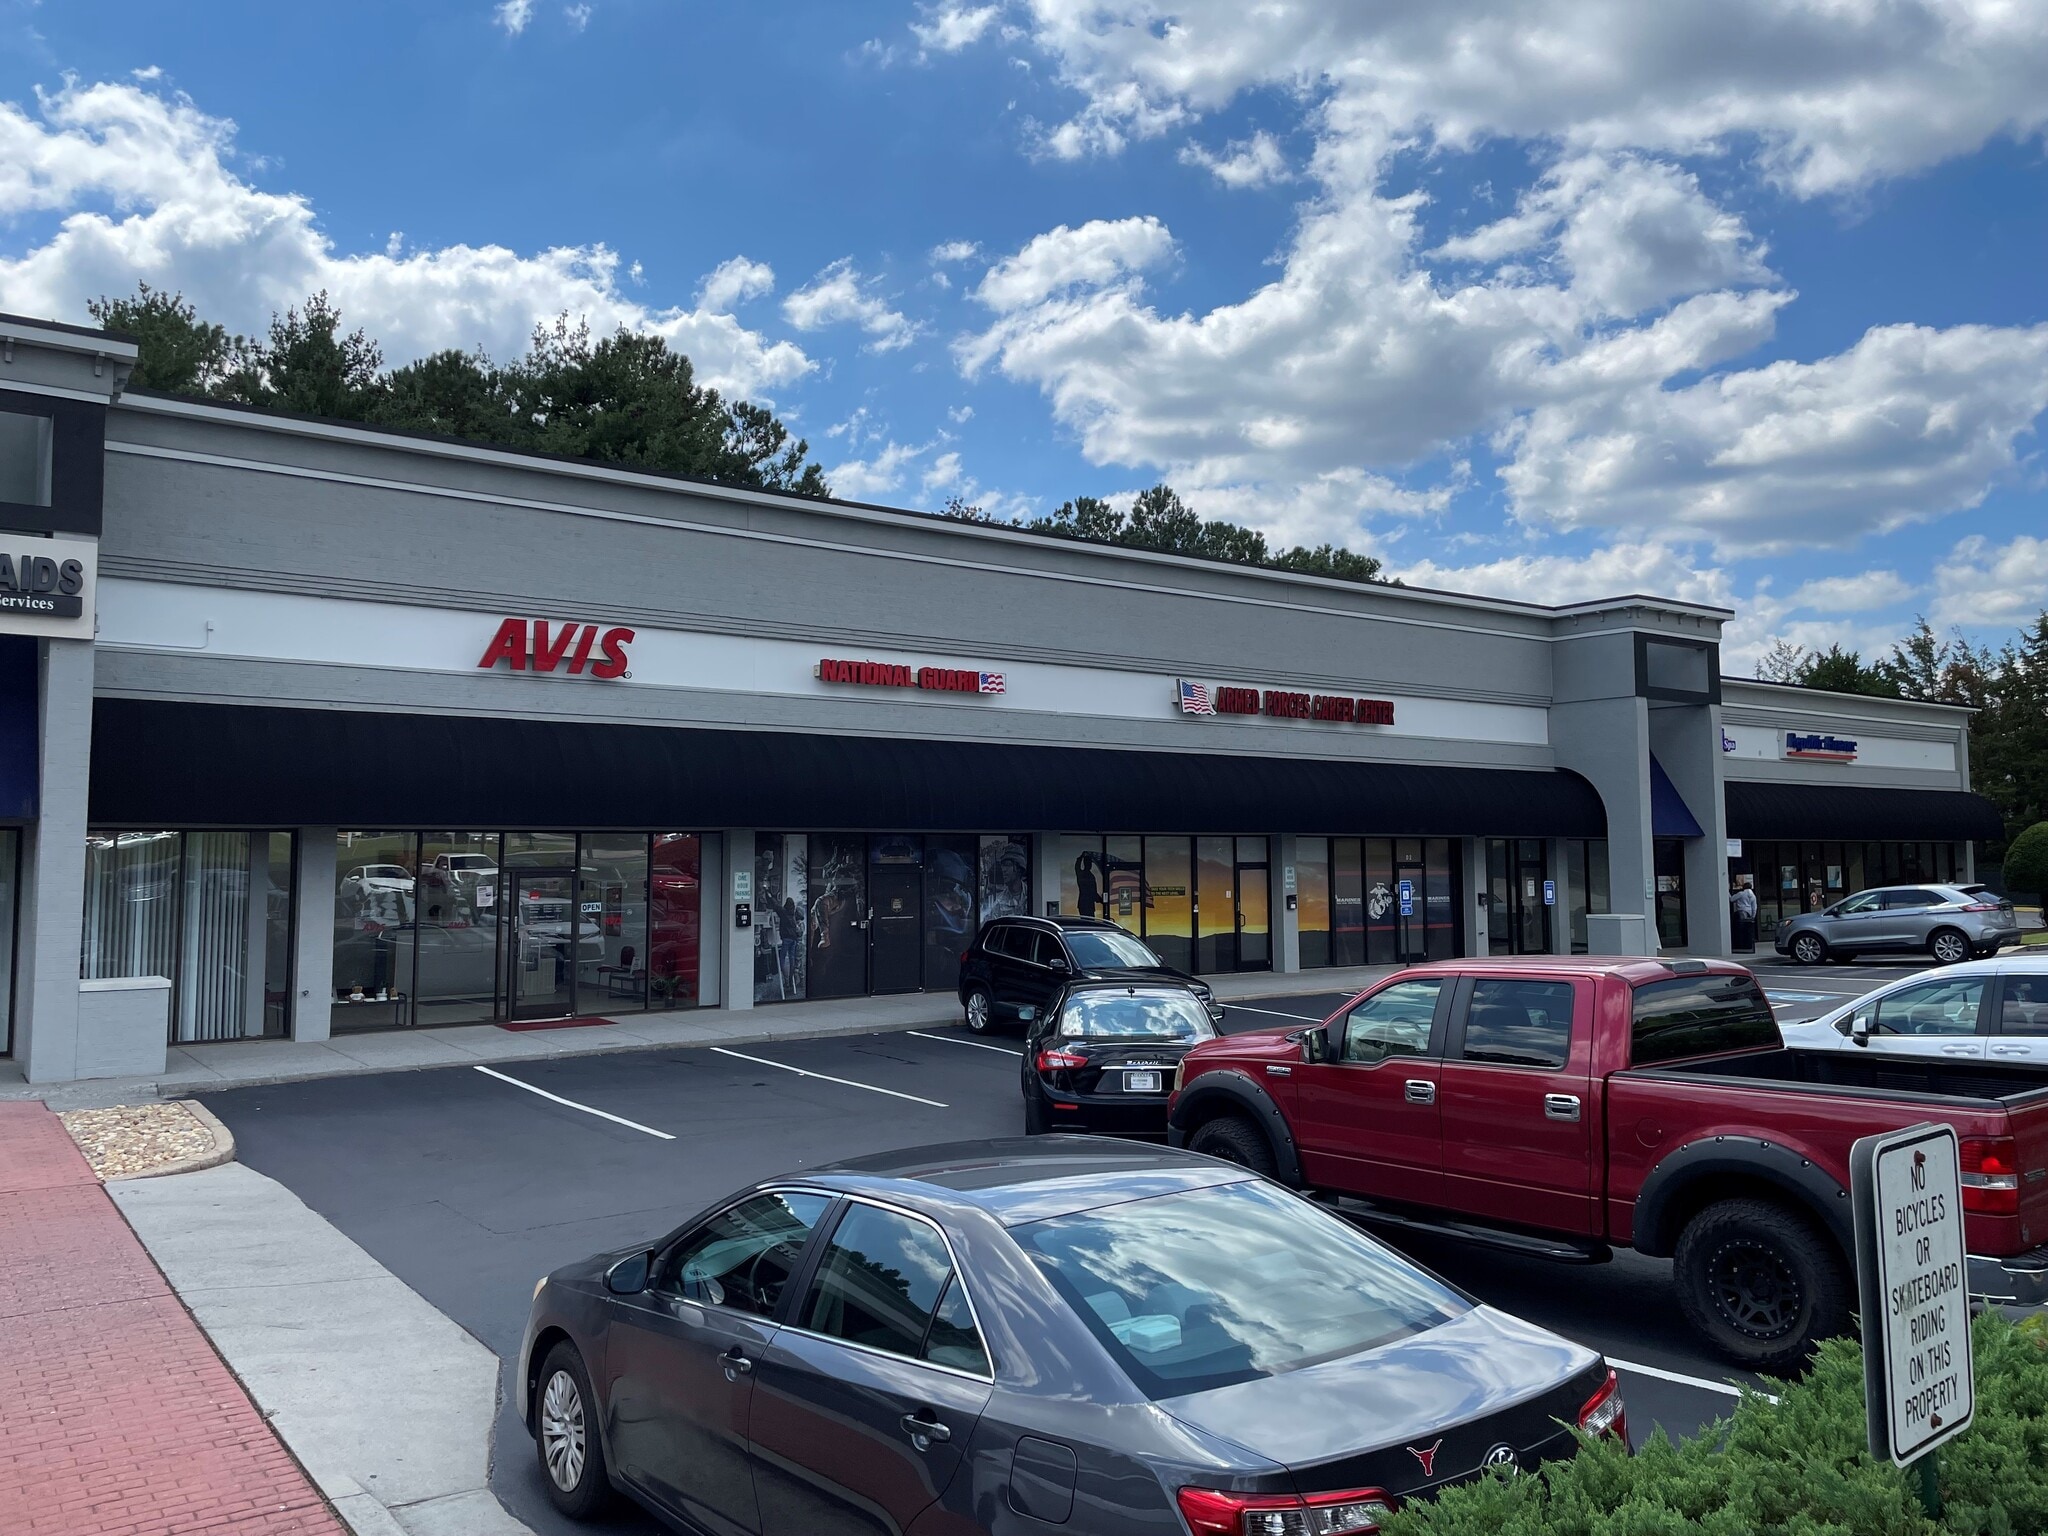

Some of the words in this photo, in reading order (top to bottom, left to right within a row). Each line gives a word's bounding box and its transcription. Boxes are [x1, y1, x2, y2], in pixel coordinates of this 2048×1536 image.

[0, 553, 83, 595] AIDS
[0, 594, 54, 610] ervices
[477, 618, 635, 679] AVIS
[820, 659, 916, 687] NATIONAL
[918, 667, 979, 692] GUARD
[1215, 687, 1259, 715] ARMED
[1263, 690, 1311, 719] FORCES
[1311, 695, 1354, 722] CAREER
[1355, 699, 1394, 725] CENTER
[582, 904, 601, 912] OPEN
[1911, 1163, 1926, 1193] NO
[1896, 1194, 1945, 1236] BICYCLES
[1916, 1237, 1931, 1266] OR
[1892, 1263, 1959, 1315] SKATEBOARD
[1911, 1305, 1946, 1346] RIDING
[1909, 1353, 1925, 1385] ON
[1927, 1340, 1951, 1375] THIS
[1905, 1373, 1958, 1428] PROPERTY
